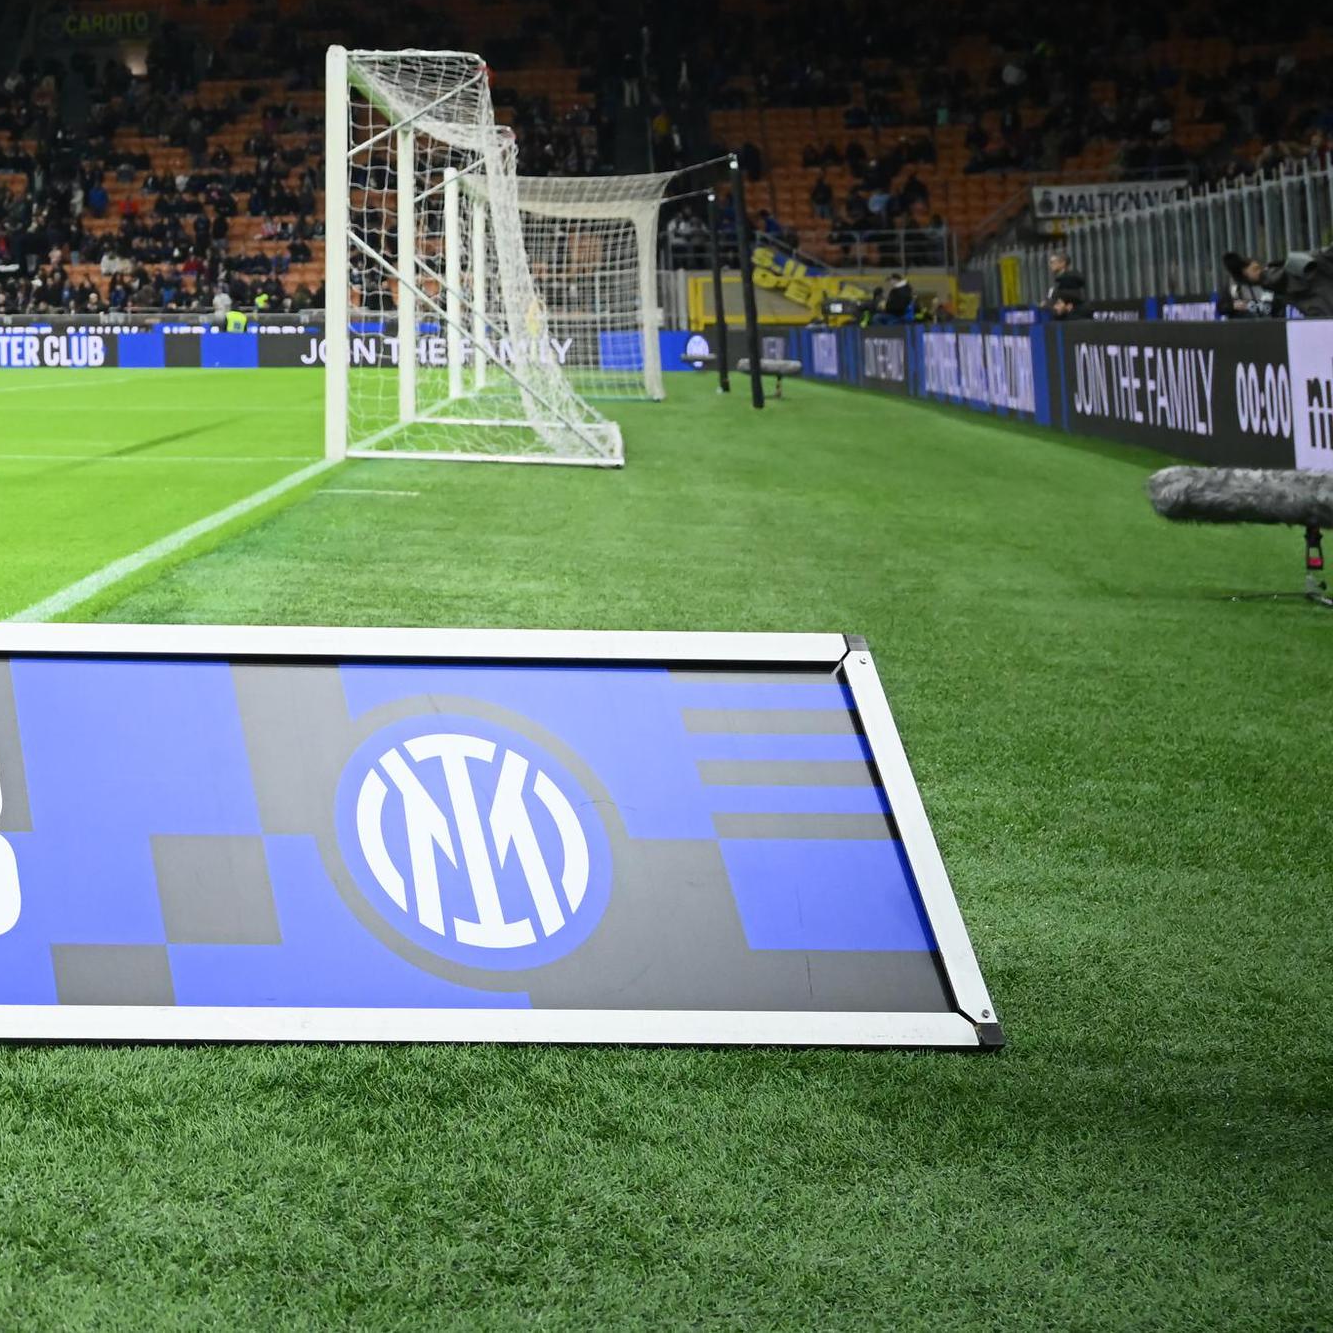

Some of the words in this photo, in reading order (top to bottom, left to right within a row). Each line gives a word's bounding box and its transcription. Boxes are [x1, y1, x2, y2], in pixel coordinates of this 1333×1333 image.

[65, 10, 150, 38] CARDITO
[43, 335, 105, 367] CLUB
[1073, 342, 1110, 417] JOIN
[1106, 345, 1144, 424] THE
[1143, 345, 1214, 437] FAMILY
[1235, 361, 1293, 440] 00:00
